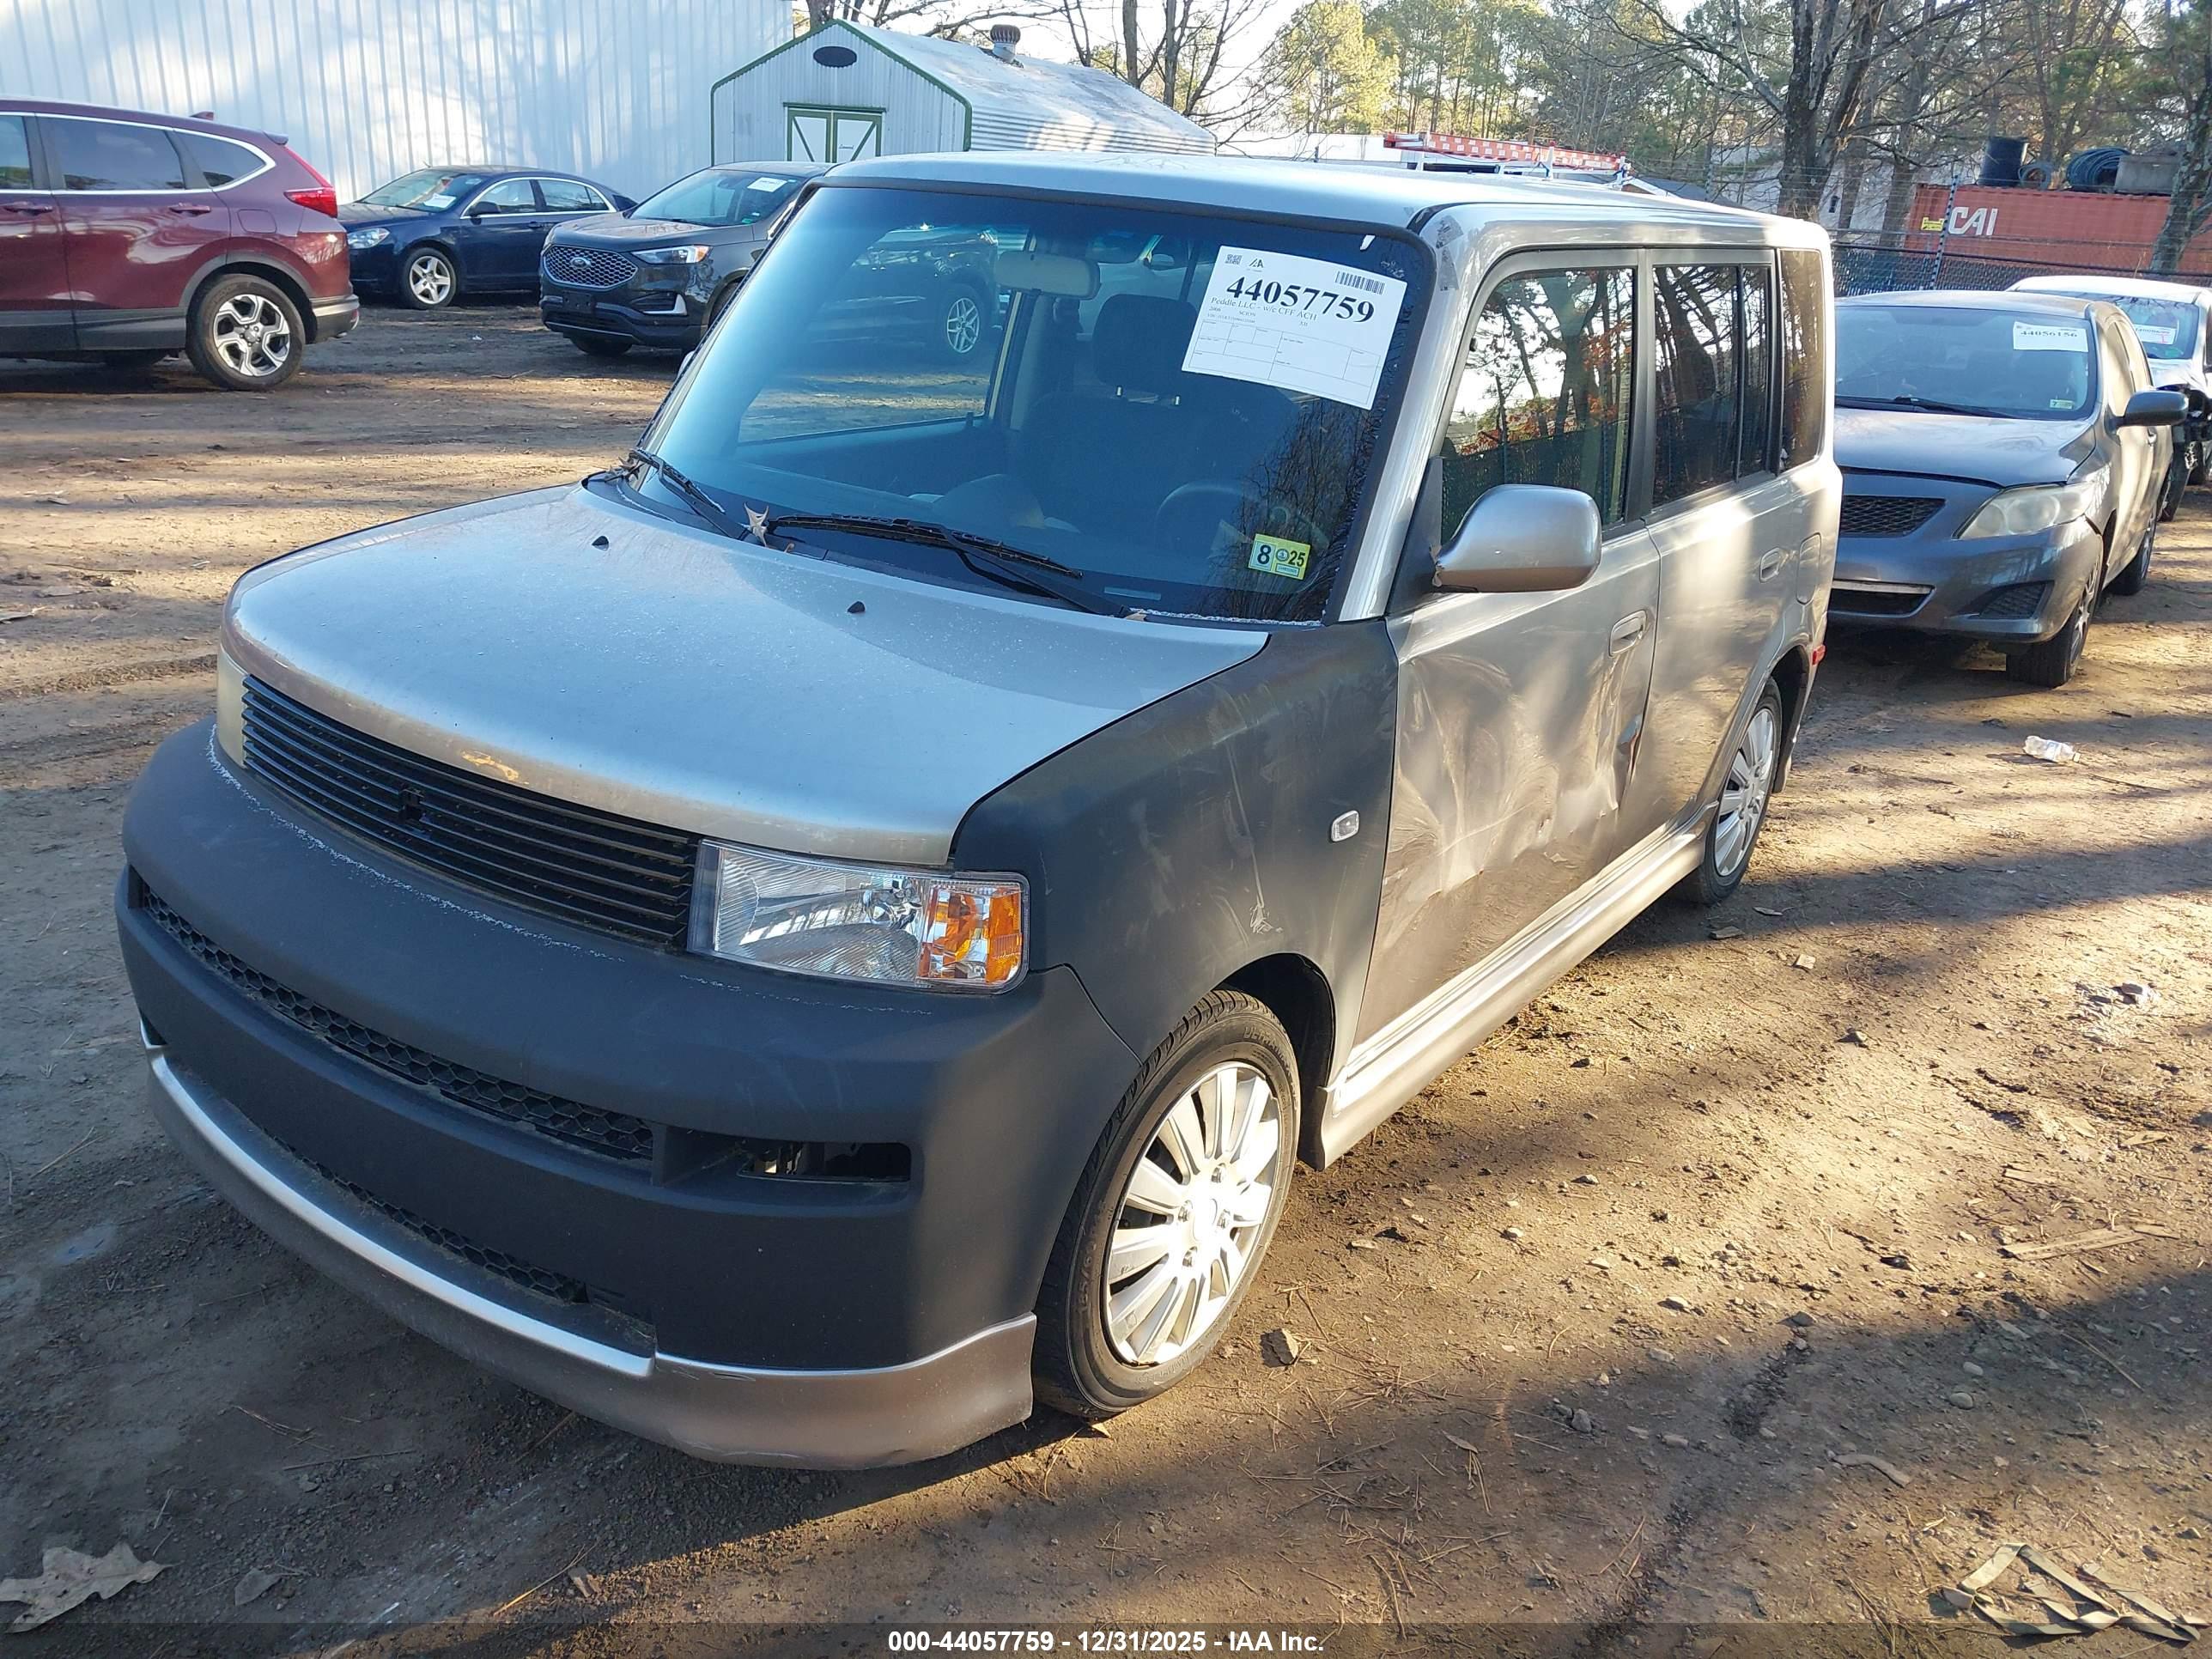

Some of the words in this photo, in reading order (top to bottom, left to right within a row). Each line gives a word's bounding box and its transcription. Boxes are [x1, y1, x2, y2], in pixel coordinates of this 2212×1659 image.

[1948, 207, 1997, 235] CAI
[1211, 296, 1237, 307] Peddle
[1238, 301, 1255, 310] LLC
[1226, 276, 1375, 323] 44057759
[1257, 544, 1271, 564] 8
[1288, 550, 1305, 567] 25
